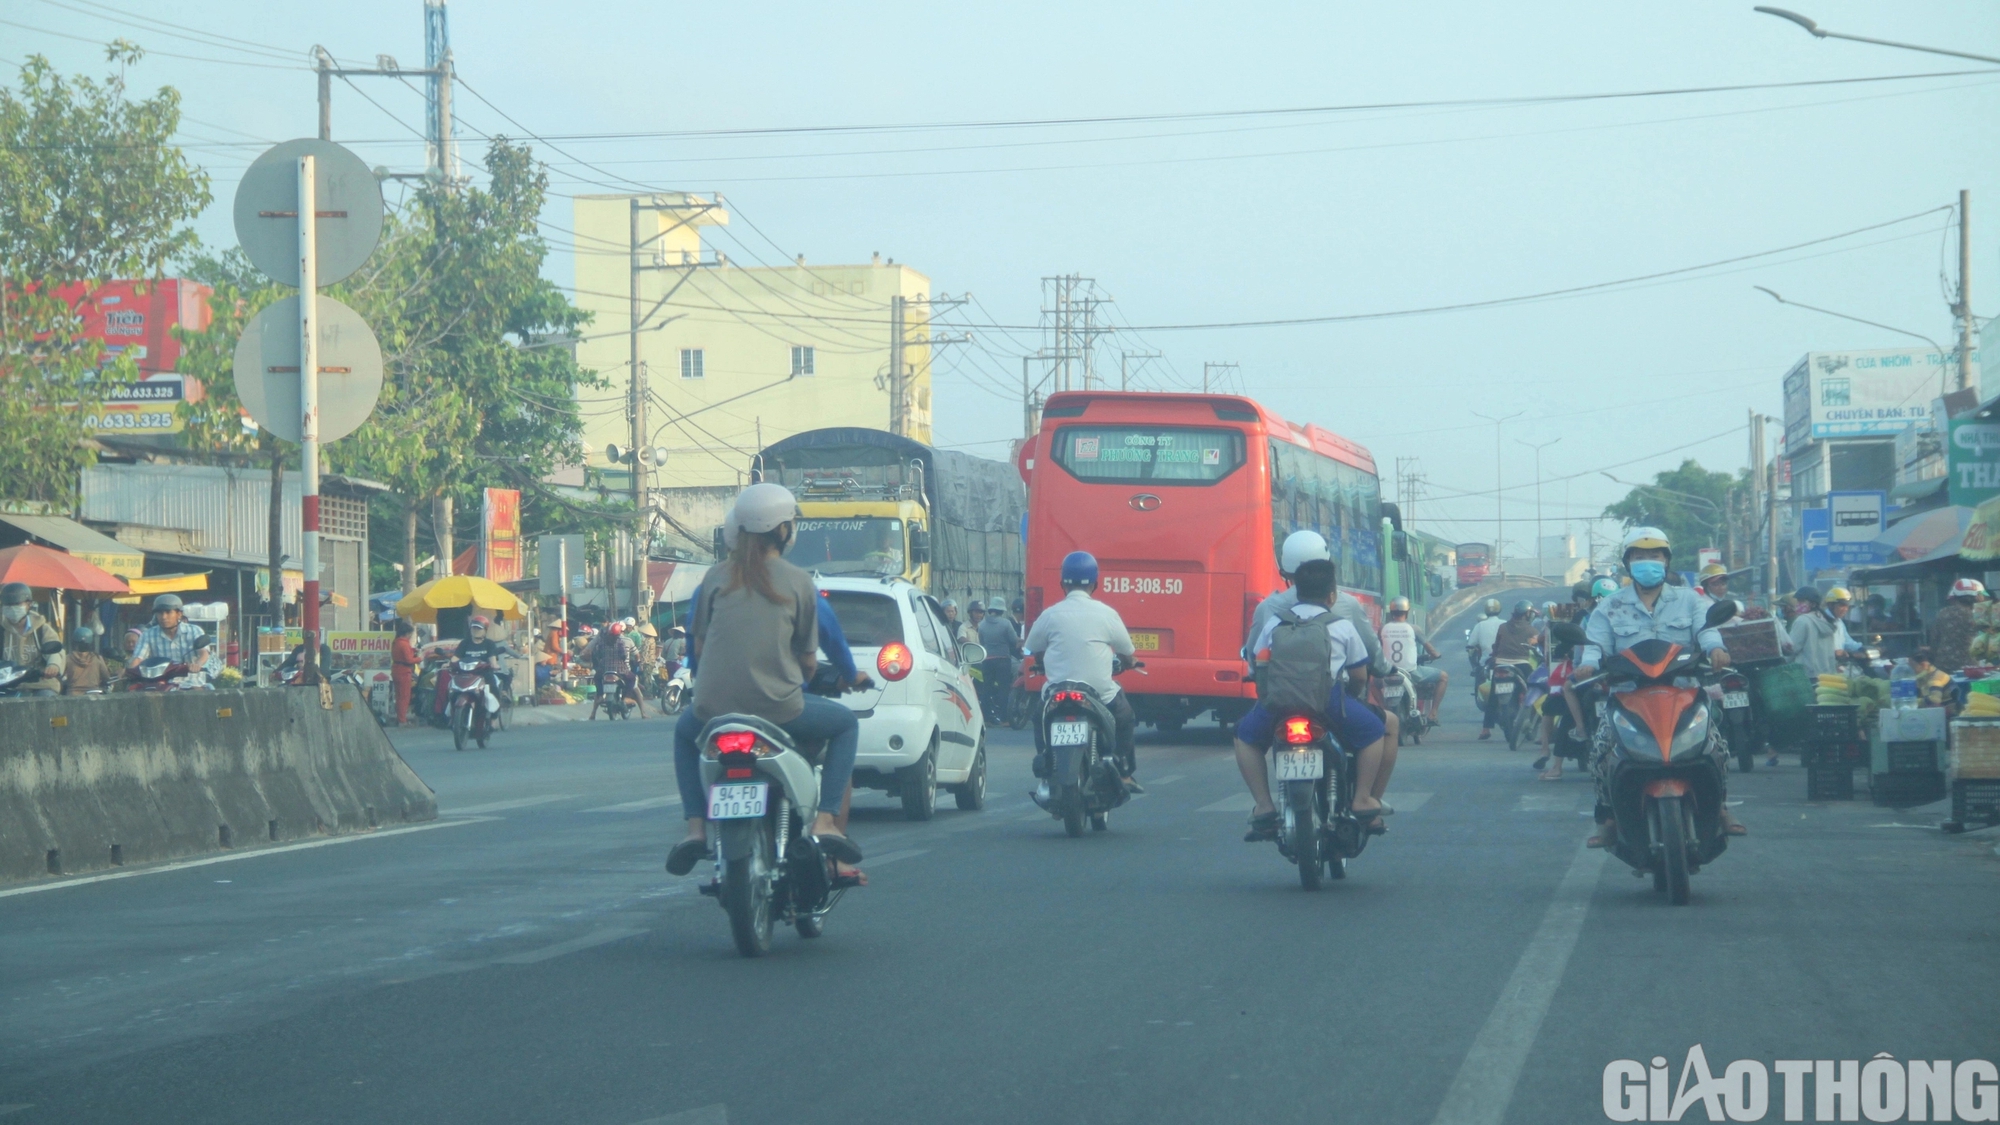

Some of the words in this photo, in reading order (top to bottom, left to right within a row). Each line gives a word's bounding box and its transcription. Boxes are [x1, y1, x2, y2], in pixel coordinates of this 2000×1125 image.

[1881, 354, 1912, 367] NHÔM
[1826, 407, 1873, 421] CHUYÊN
[1124, 434, 1155, 446] CÔNG
[1101, 447, 1152, 462] PHƯƠNG
[1156, 449, 1199, 463] TRANG
[797, 521, 867, 531] IDGESTONE
[1103, 577, 1183, 595] 51B-308.50
[332, 638, 357, 651] CƠM
[1135, 634, 1150, 642] 51B
[1133, 642, 1156, 650] 08.50
[1391, 640, 1404, 664] 8
[1283, 752, 1316, 765] 94-H3
[1283, 765, 1316, 778] 7147
[719, 786, 758, 801] 94-FD
[712, 800, 762, 817] 010.50
